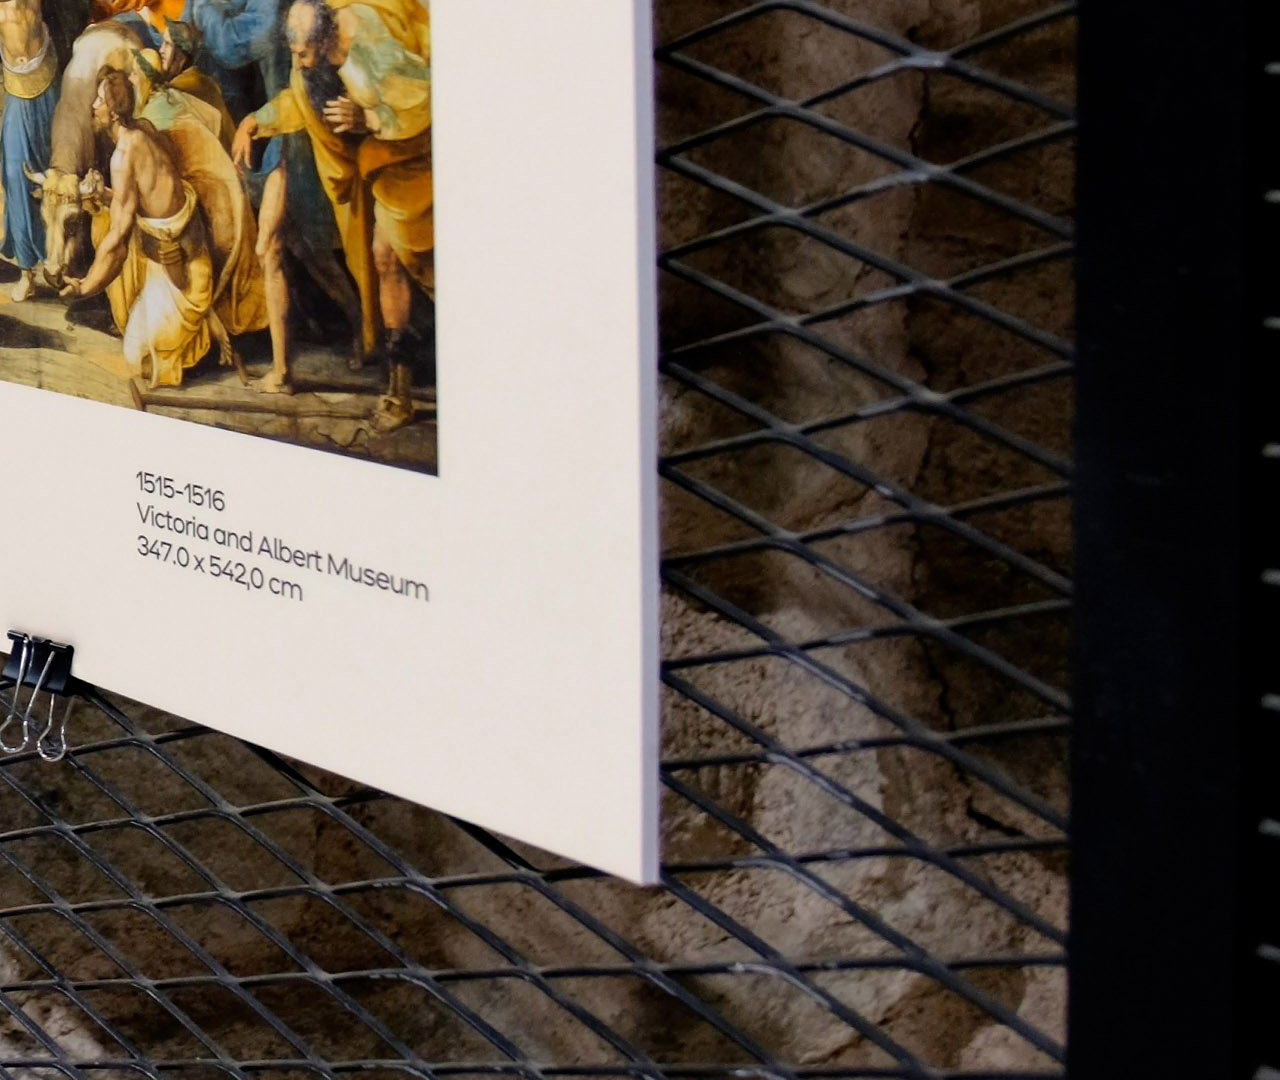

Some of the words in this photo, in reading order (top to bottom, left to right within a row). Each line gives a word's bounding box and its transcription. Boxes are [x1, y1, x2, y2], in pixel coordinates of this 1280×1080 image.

[136, 471, 225, 511] 1515-1516
[137, 502, 209, 541] Victoria
[213, 526, 253, 553] and
[257, 536, 323, 572] Albert
[327, 553, 430, 602] Museum
[137, 535, 190, 567] 347.0
[193, 555, 206, 573] x
[209, 555, 264, 590] 542,0
[268, 575, 303, 601] cm
